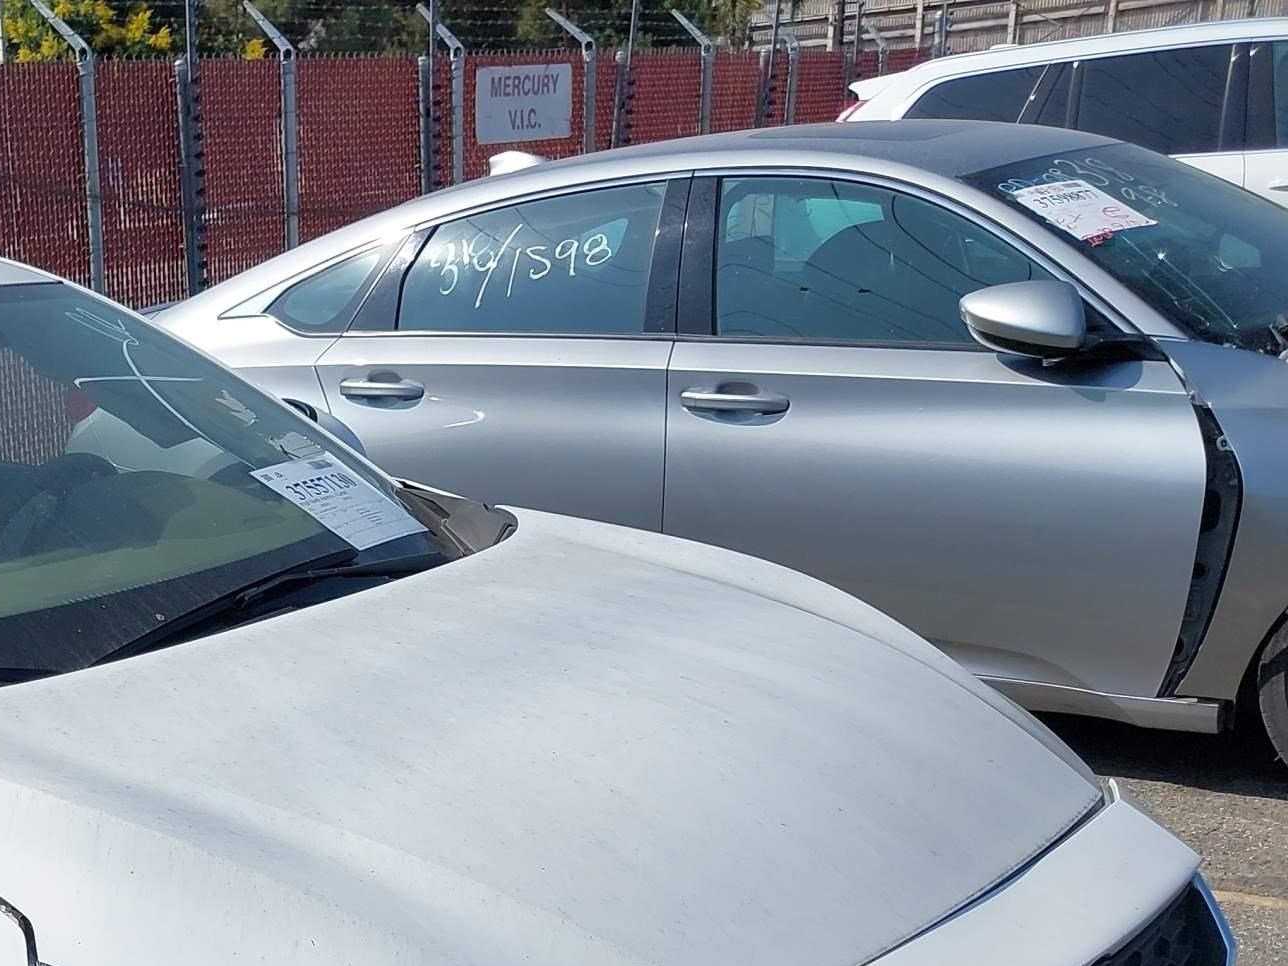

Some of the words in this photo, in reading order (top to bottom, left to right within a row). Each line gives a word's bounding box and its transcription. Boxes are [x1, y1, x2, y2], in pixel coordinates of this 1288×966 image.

[490, 73, 560, 98] MERCURY
[508, 108, 542, 131] V.I.C.
[285, 472, 358, 501] 37557130
